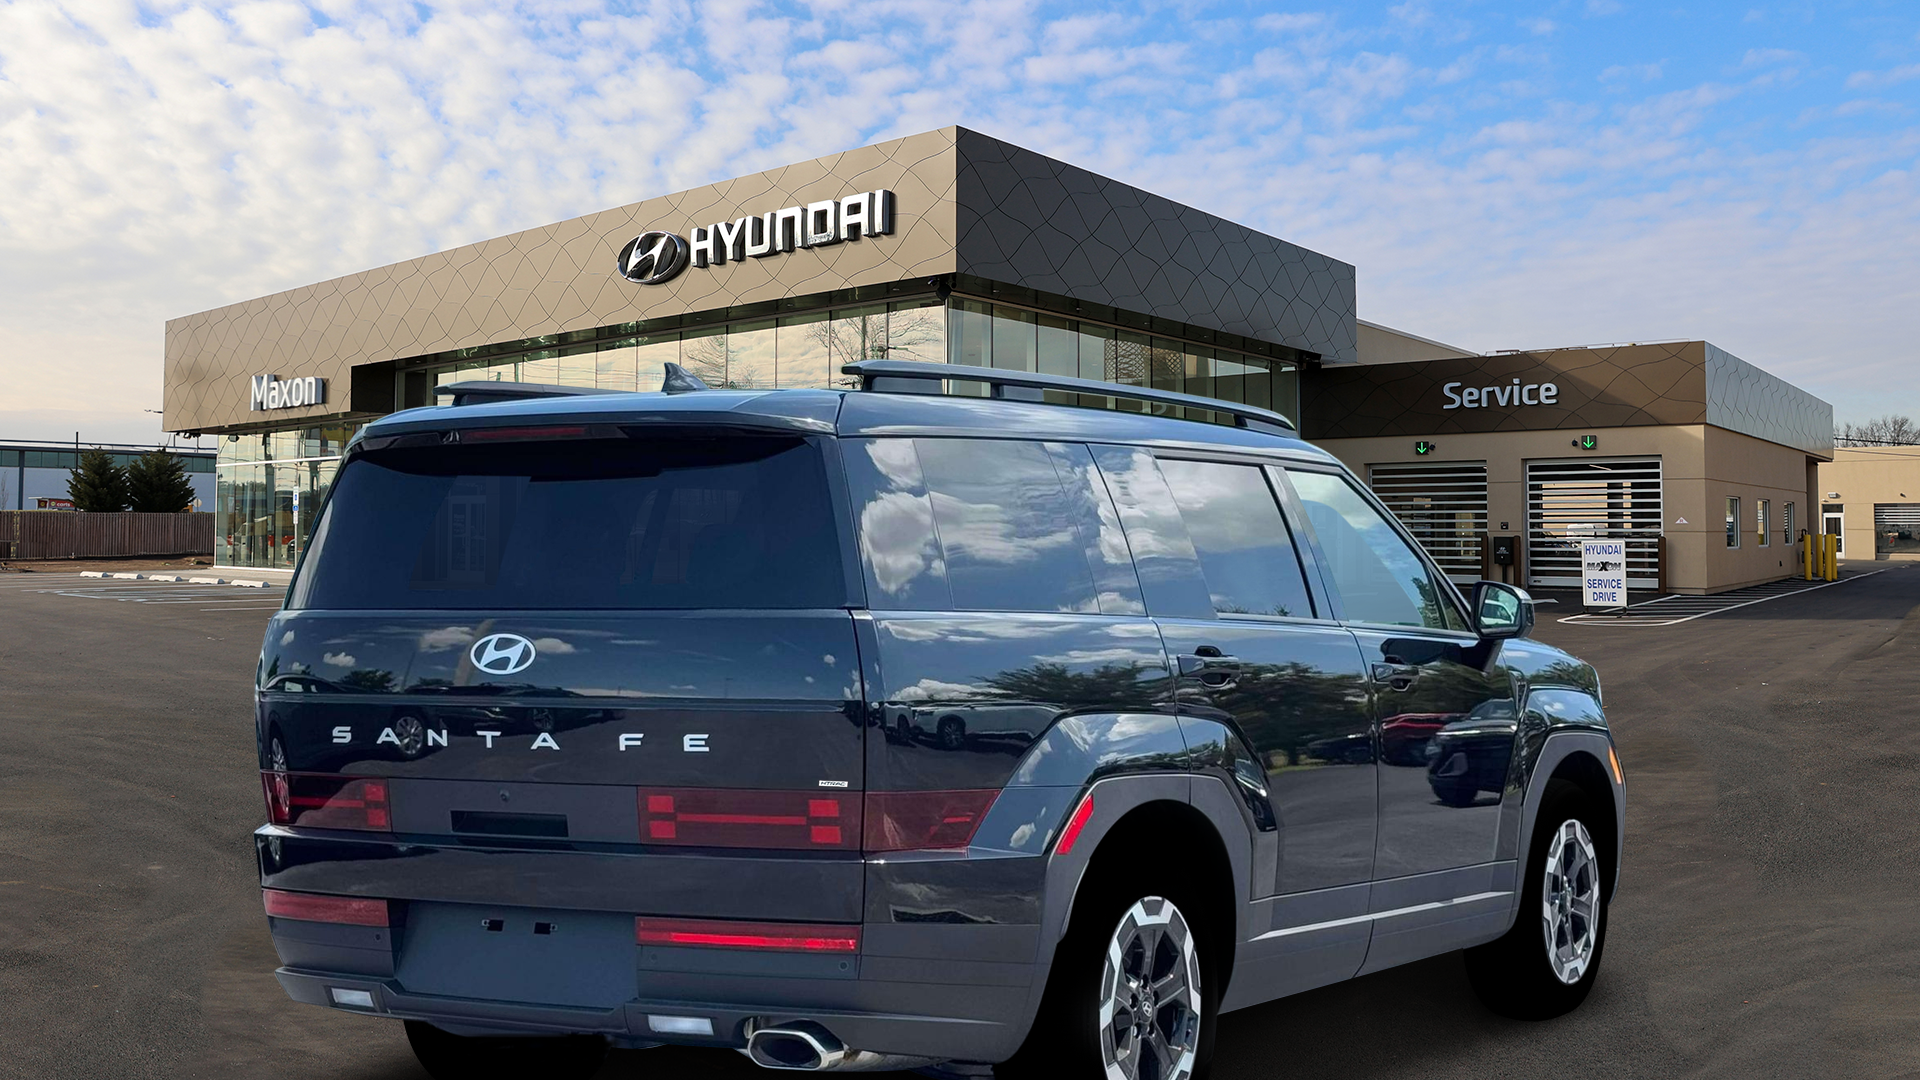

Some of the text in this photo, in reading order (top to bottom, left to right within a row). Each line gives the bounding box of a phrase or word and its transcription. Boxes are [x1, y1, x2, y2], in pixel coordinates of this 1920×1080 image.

[689, 189, 896, 267] HYUNDAI
[250, 374, 320, 411] Maxon
[1442, 378, 1558, 409] Service
[1585, 545, 1622, 555] HYUNDAI
[1586, 561, 1621, 571] MAXON
[1587, 579, 1622, 589] SERVICE
[1593, 592, 1617, 602] DRIVE
[332, 726, 710, 752] SANTA FE
